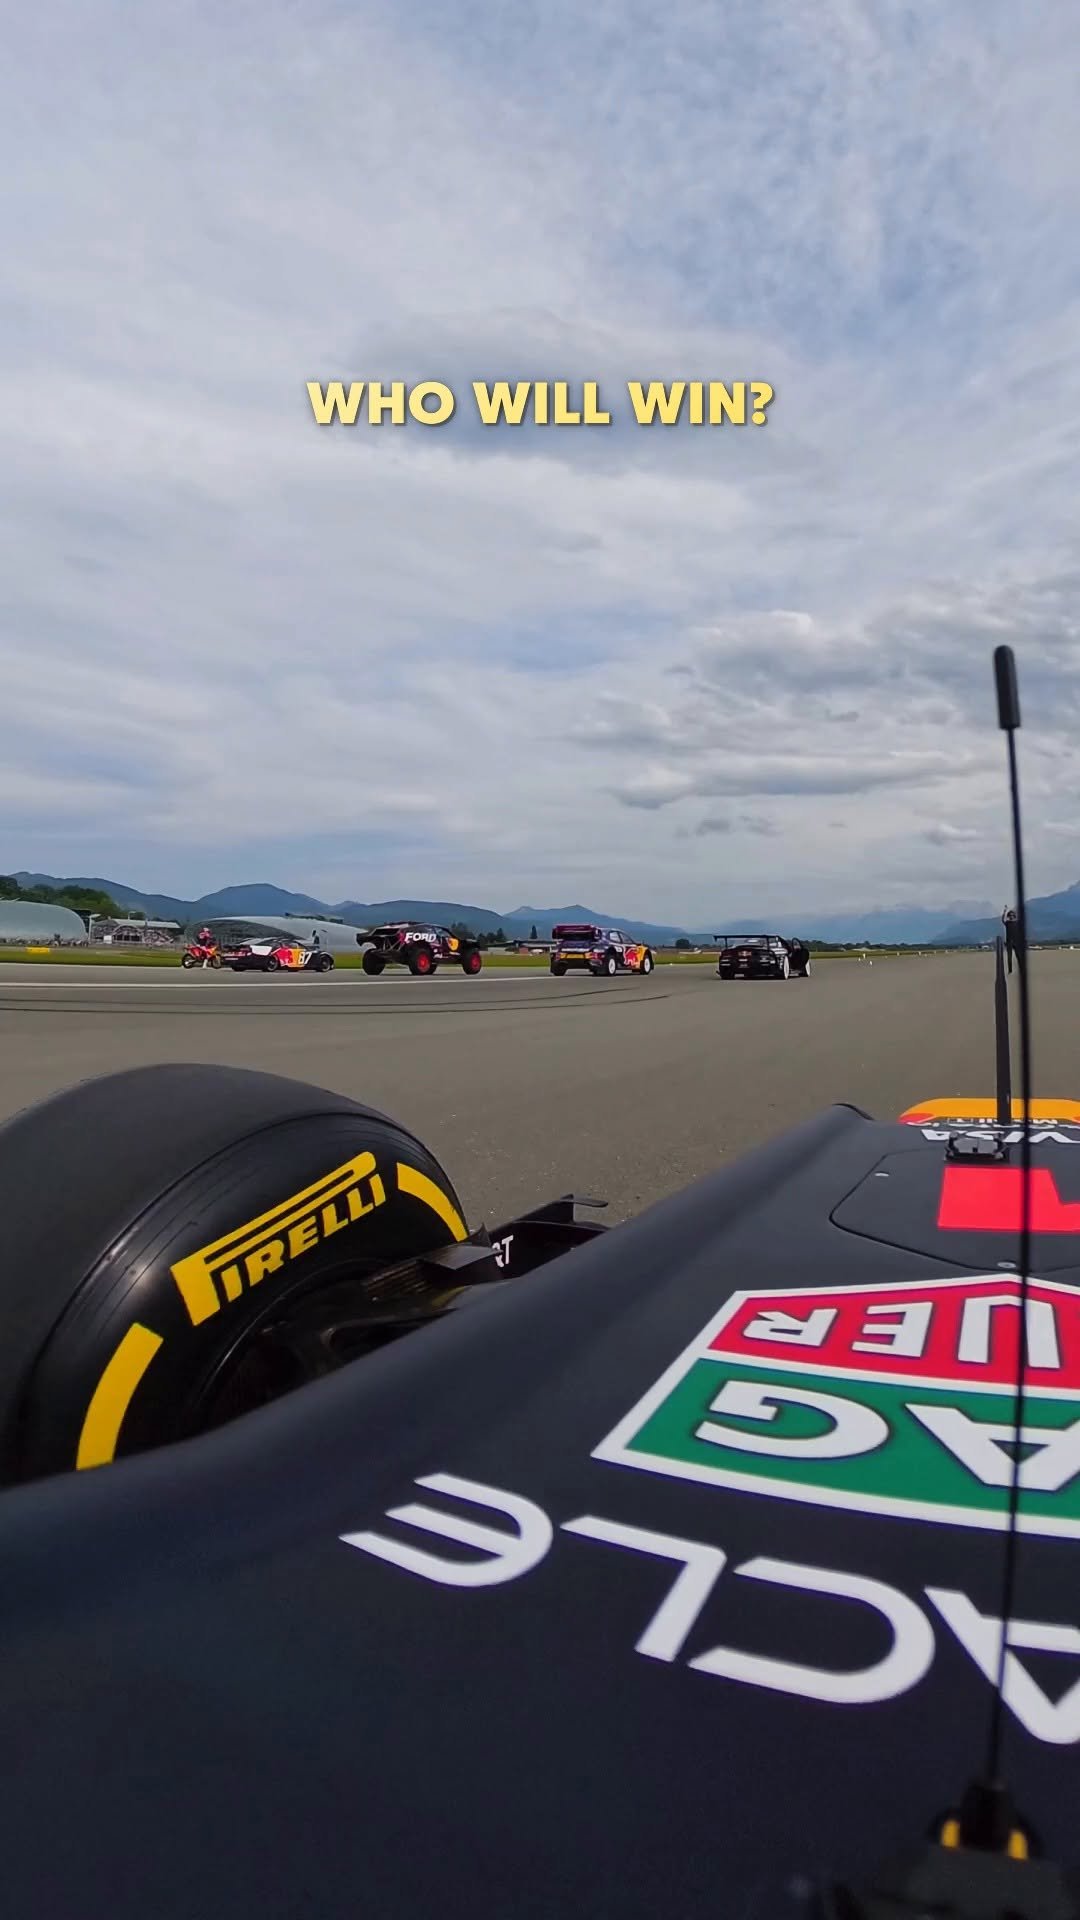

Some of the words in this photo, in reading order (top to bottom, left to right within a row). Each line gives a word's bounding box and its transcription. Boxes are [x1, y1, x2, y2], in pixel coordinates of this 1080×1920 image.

[404, 932, 437, 943] FORD
[298, 951, 313, 965] 87
[920, 1129, 1080, 1144] VISA
[169, 1151, 387, 1326] PIRELLI
